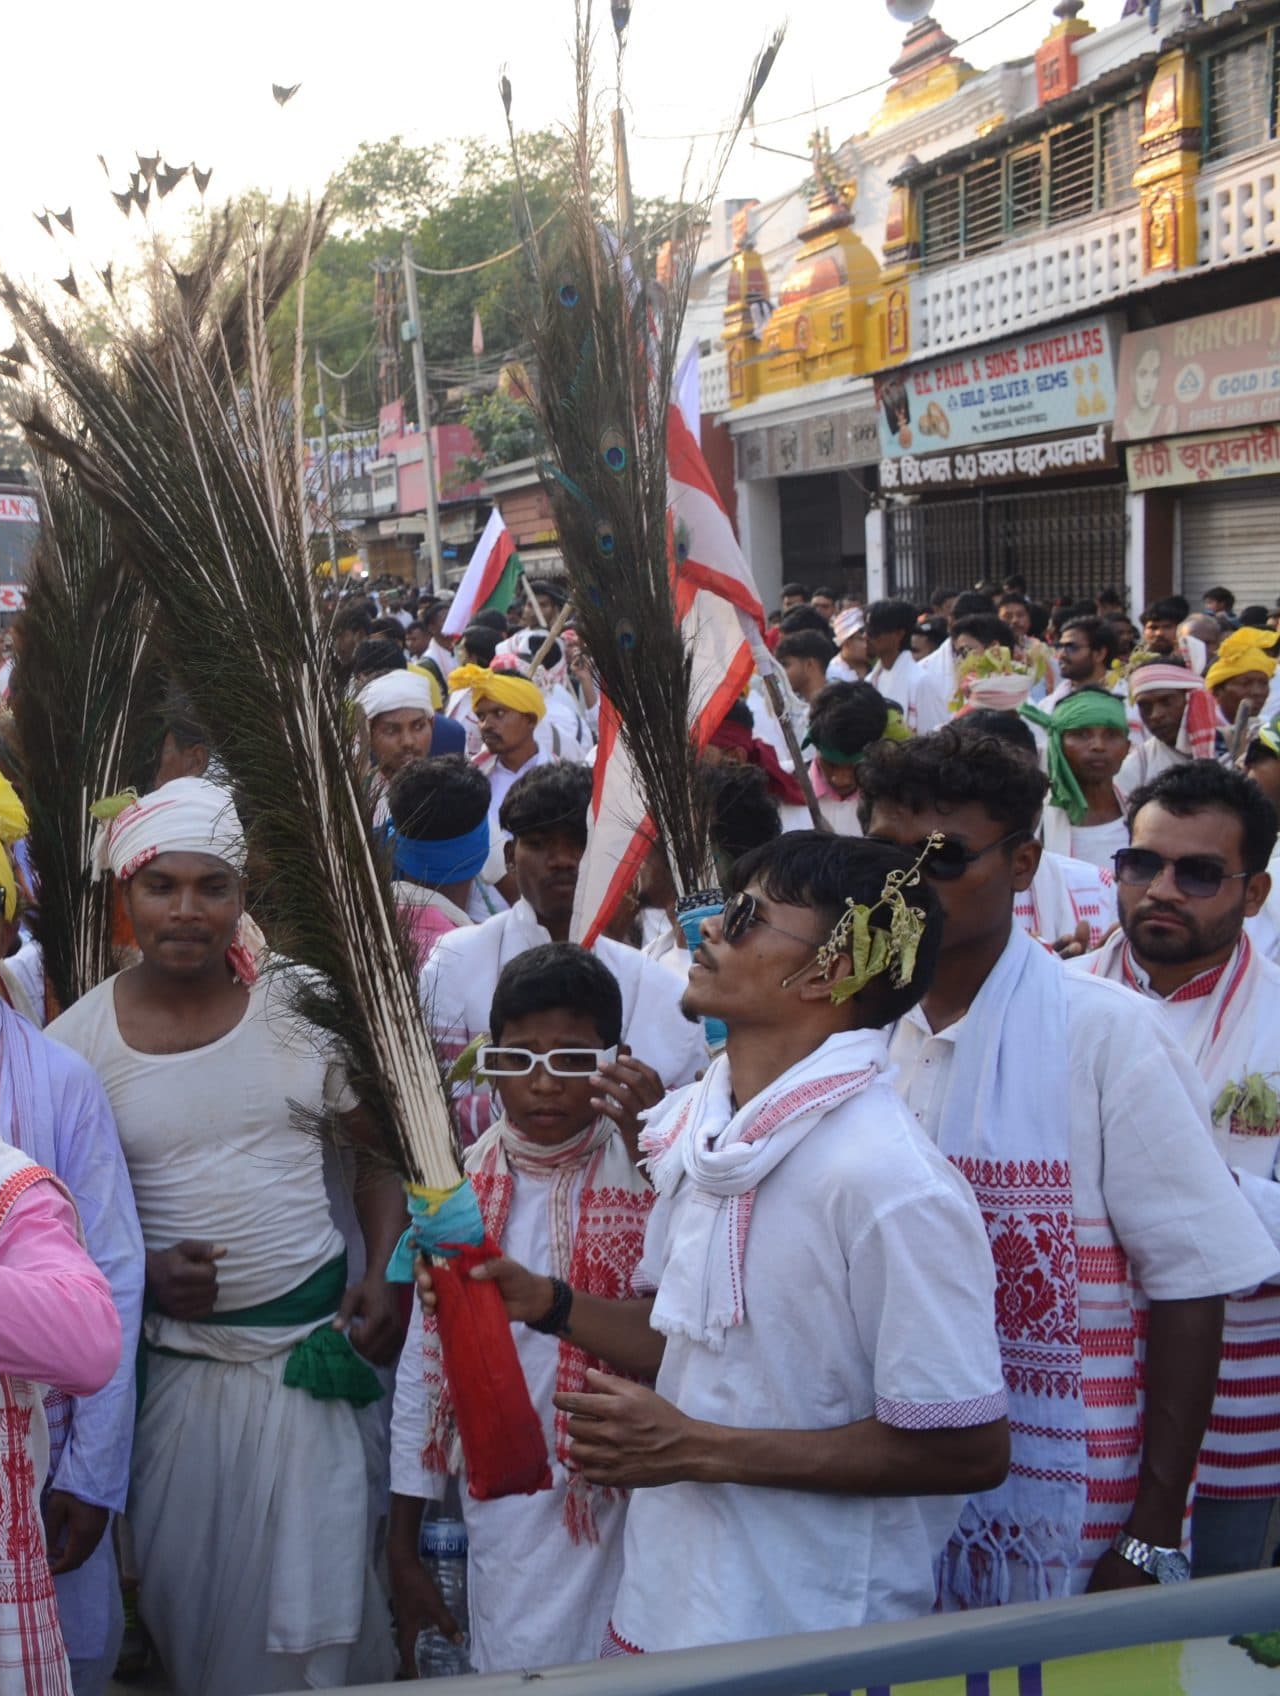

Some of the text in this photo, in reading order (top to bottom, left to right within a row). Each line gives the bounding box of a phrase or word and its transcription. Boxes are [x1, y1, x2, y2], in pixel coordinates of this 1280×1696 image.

[1173, 306, 1262, 360] RANCHI
[935, 361, 969, 391] PAUL
[984, 348, 1019, 379] SONS
[1023, 326, 1105, 371] JEWELLRS
[960, 370, 1069, 408] GOLD SILVER GEMS
[1217, 373, 1258, 396] GOLD
